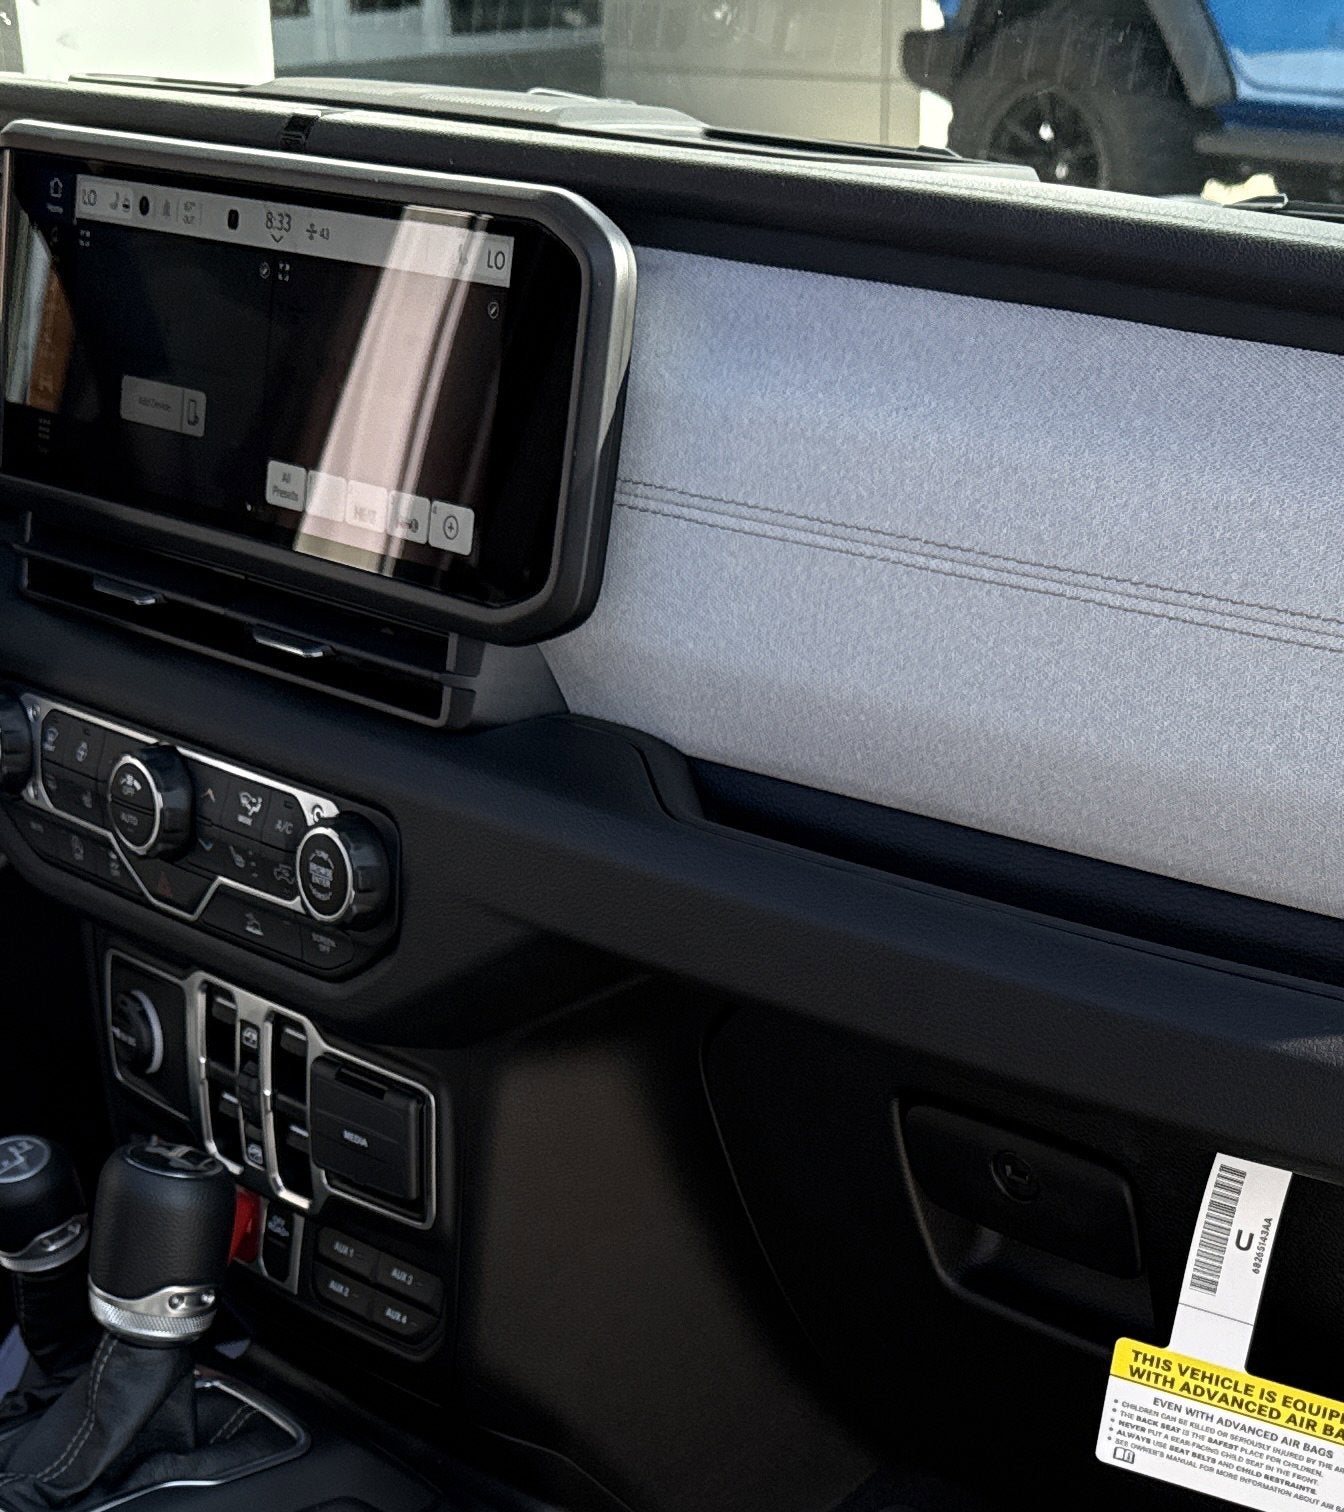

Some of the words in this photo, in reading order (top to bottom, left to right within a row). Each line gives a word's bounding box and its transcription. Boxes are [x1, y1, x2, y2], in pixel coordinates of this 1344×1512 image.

[265, 211, 292, 233] 8:33
[487, 250, 506, 270] LO
[275, 818, 294, 835] A/C
[334, 1241, 349, 1256] AUX
[1235, 1229, 1254, 1251] U
[391, 1268, 407, 1283] AUX
[386, 1307, 402, 1322] AUX
[1129, 1364, 1175, 1389] WITH
[1179, 1382, 1281, 1420] ADVANCED
[1285, 1413, 1318, 1432] AIR
[1132, 1349, 1172, 1372] THIS
[1178, 1363, 1255, 1397] VEHICLE
[1258, 1388, 1277, 1404] IS
[1118, 1419, 1146, 1433] NEVER
[1147, 1428, 1163, 1438] PUT
[1220, 1450, 1244, 1463] CHILD
[1245, 1458, 1264, 1469] SEAT
[1265, 1464, 1274, 1472] IN
[1276, 1467, 1291, 1477] THE
[1120, 1410, 1134, 1420] THE
[1136, 1415, 1159, 1427] BACK
[1160, 1422, 1181, 1433] SEAT
[1181, 1428, 1190, 1437] IS
[1191, 1431, 1206, 1442] THE
[1207, 1436, 1239, 1451] SAFEST
[1239, 1446, 1264, 1460] PLACE
[1265, 1454, 1282, 1464] FOR
[1121, 1401, 1160, 1417] CHILDREN
[1160, 1412, 1177, 1423] CAN
[1189, 1421, 1216, 1434] KILLED
[1216, 1429, 1229, 1438] OR
[1229, 1433, 1271, 1451] SERIOUSLY
[1272, 1446, 1305, 1462] INJURED
[1305, 1456, 1316, 1465] BY
[1318, 1460, 1333, 1471] THE
[1152, 1397, 1182, 1413] EVEN
[1185, 1407, 1214, 1422] WITH
[1216, 1417, 1278, 1442] ADVANCED
[1280, 1436, 1300, 1449] AIR
[1302, 1442, 1334, 1459] BAGS
[1116, 1429, 1151, 1444] ALWAYS
[1152, 1439, 1168, 1450] USE
[1168, 1444, 1190, 1456] SEAT
[1191, 1451, 1216, 1464] BELTS
[1217, 1460, 1235, 1470] AND
[1235, 1465, 1262, 1478] CHILD
[1165, 1453, 1197, 1468] MANUAL
[1198, 1463, 1215, 1473] FOR
[1215, 1468, 1238, 1481] MORE
[1239, 1476, 1292, 1497] INFORMATION
[1292, 1493, 1320, 1505] ABOUT
[1320, 1501, 1335, 1510] AIR
